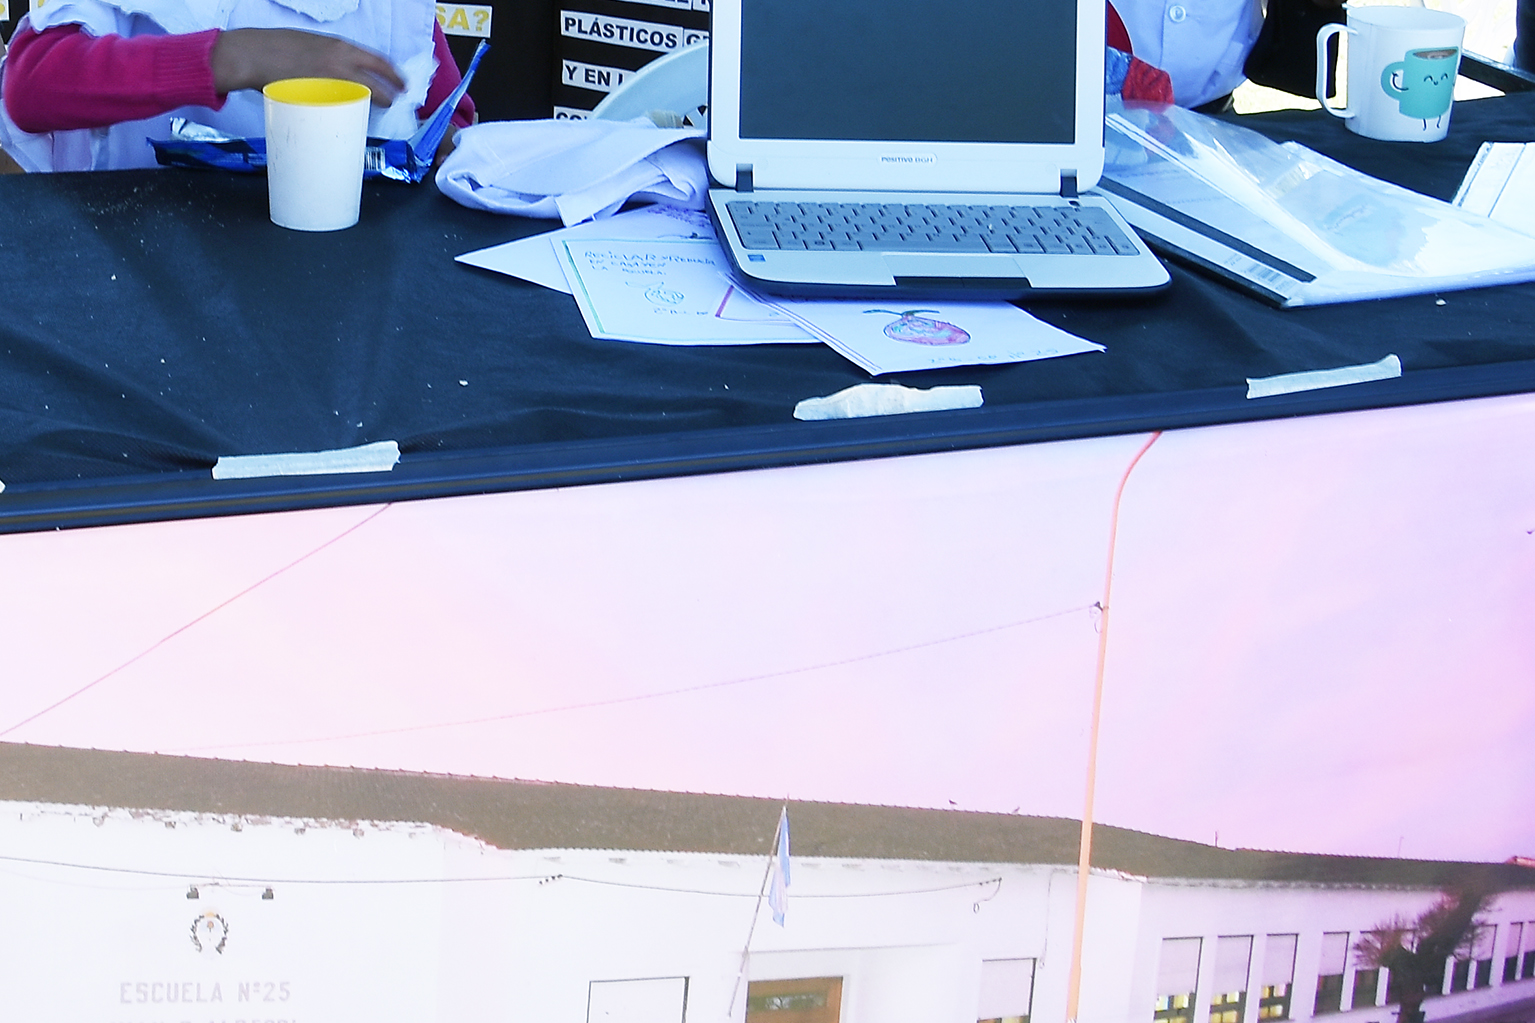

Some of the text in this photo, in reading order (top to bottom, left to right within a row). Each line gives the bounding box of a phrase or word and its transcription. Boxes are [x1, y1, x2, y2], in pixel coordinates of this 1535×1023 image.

[435, 6, 490, 32] SA?
[564, 16, 678, 48] PLÁSTICOS
[565, 66, 578, 80] Y
[584, 68, 611, 86] EN
[120, 981, 223, 1004] ESCUELA
